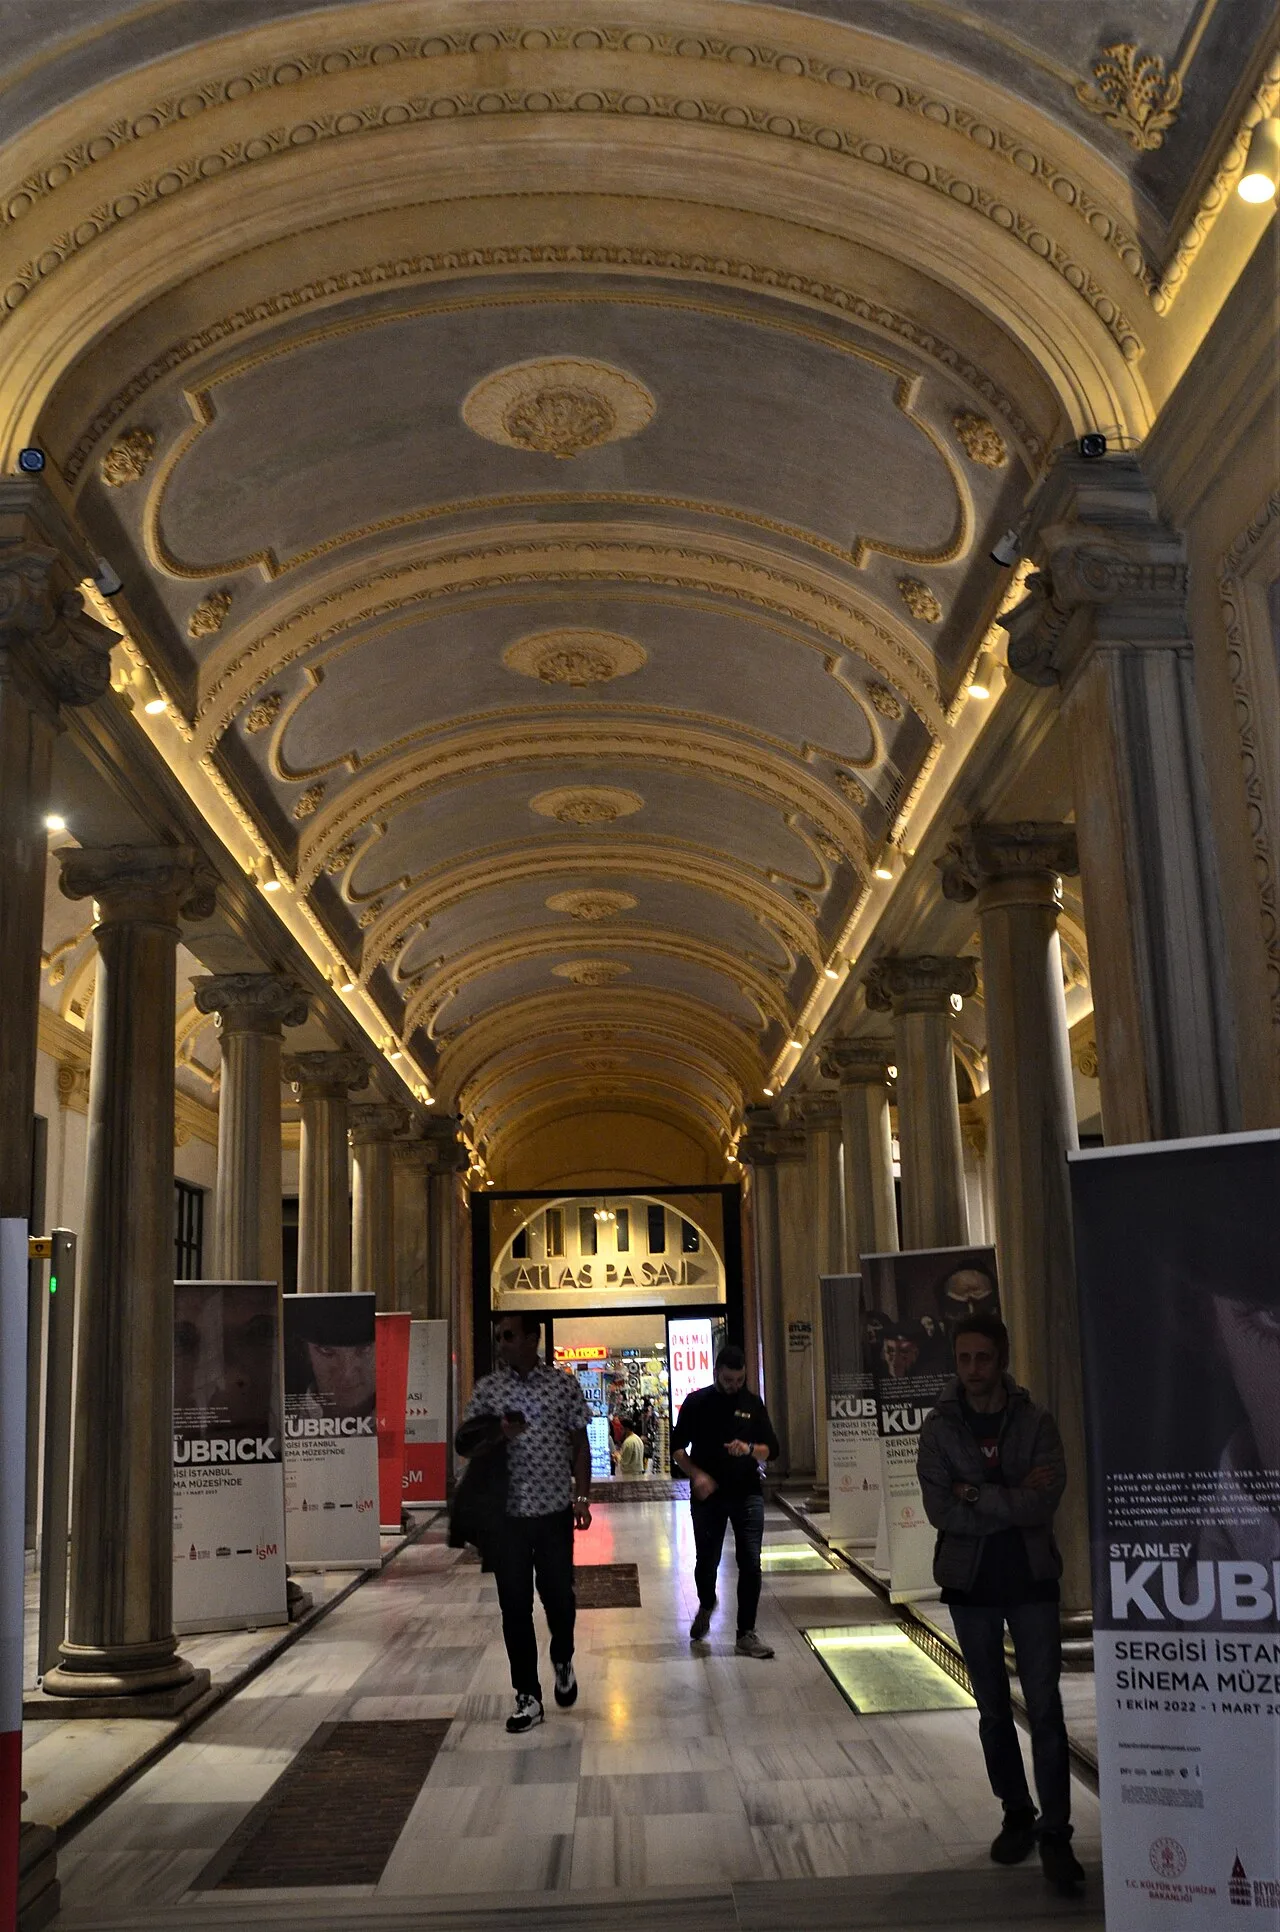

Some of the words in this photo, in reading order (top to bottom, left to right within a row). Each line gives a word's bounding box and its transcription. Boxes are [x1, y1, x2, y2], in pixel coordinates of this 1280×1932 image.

[514, 1263, 593, 1289] ATLAS
[605, 1258, 688, 1288] PASAJI
[673, 1347, 709, 1371] GÜN
[831, 1398, 877, 1418] KUB
[285, 1416, 373, 1437] UBRICK
[173, 1437, 276, 1463] UBRICK
[1113, 1473, 1134, 1481] FEAR
[1136, 1472, 1154, 1480] AND
[1156, 1472, 1185, 1480] DESIRE
[1114, 1484, 1139, 1492] PATHS
[1141, 1484, 1153, 1492] OF
[1155, 1484, 1182, 1492] GLORY
[1192, 1482, 1240, 1491] SPARTACUS
[1130, 1495, 1189, 1504] STRANGELOVE
[1114, 1508, 1120, 1516] A
[1121, 1507, 1169, 1516] CLOCKWORK
[1170, 1507, 1201, 1515] ORANGE
[1115, 1519, 1133, 1527] FULL
[1161, 1518, 1188, 1526] JACKET
[1109, 1543, 1192, 1558] STANLEY
[1109, 1560, 1280, 1621] KUB
[1115, 1638, 1206, 1662] SERGİSİ
[1116, 1666, 1209, 1692] SİNEMA
[1116, 1699, 1121, 1710] 1
[1127, 1698, 1159, 1710] EKİM
[1164, 1700, 1196, 1712] 2022
[1211, 1702, 1216, 1713] 1
[1222, 1703, 1261, 1715] MART
